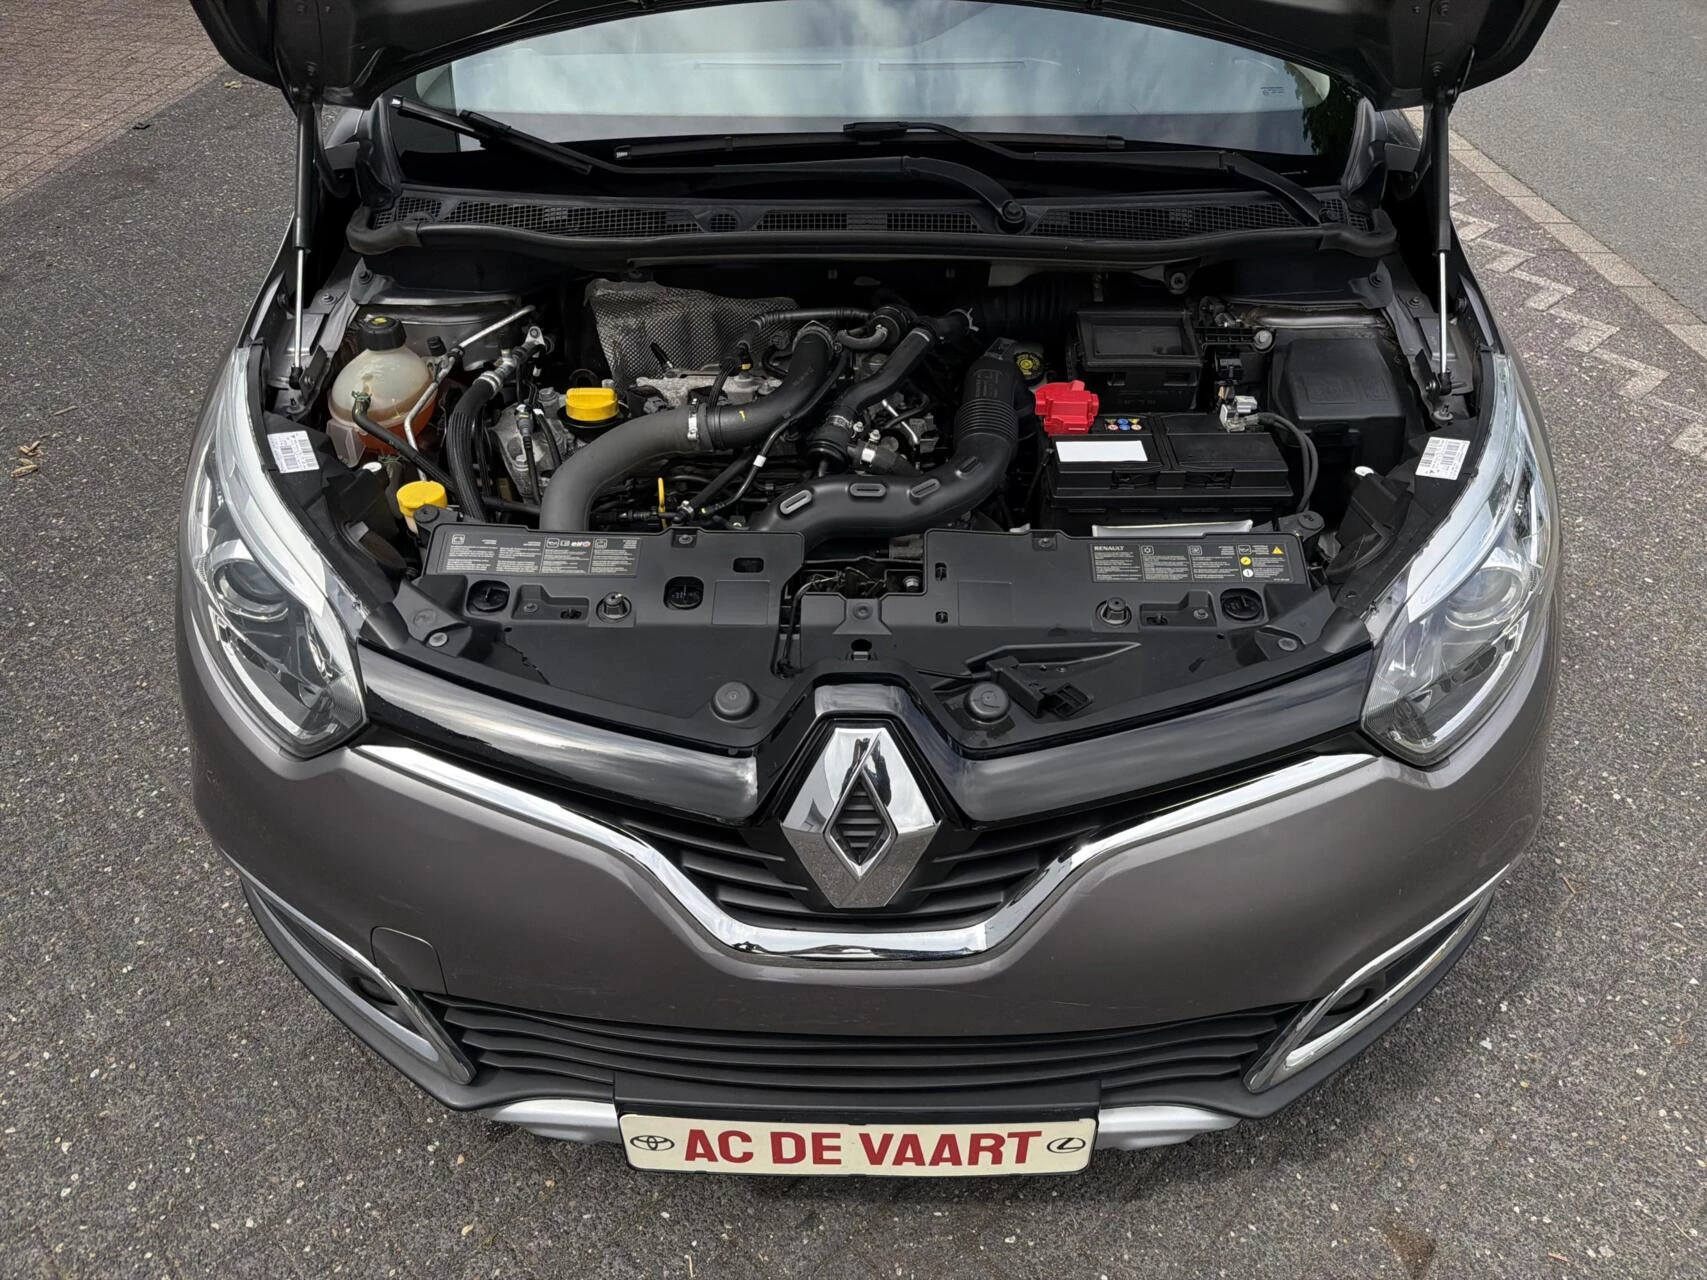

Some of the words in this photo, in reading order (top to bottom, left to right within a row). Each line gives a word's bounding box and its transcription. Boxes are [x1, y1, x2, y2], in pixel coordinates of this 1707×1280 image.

[685, 1128, 754, 1164] AC
[769, 1131, 841, 1166] DE
[859, 1130, 1041, 1167] VAART
